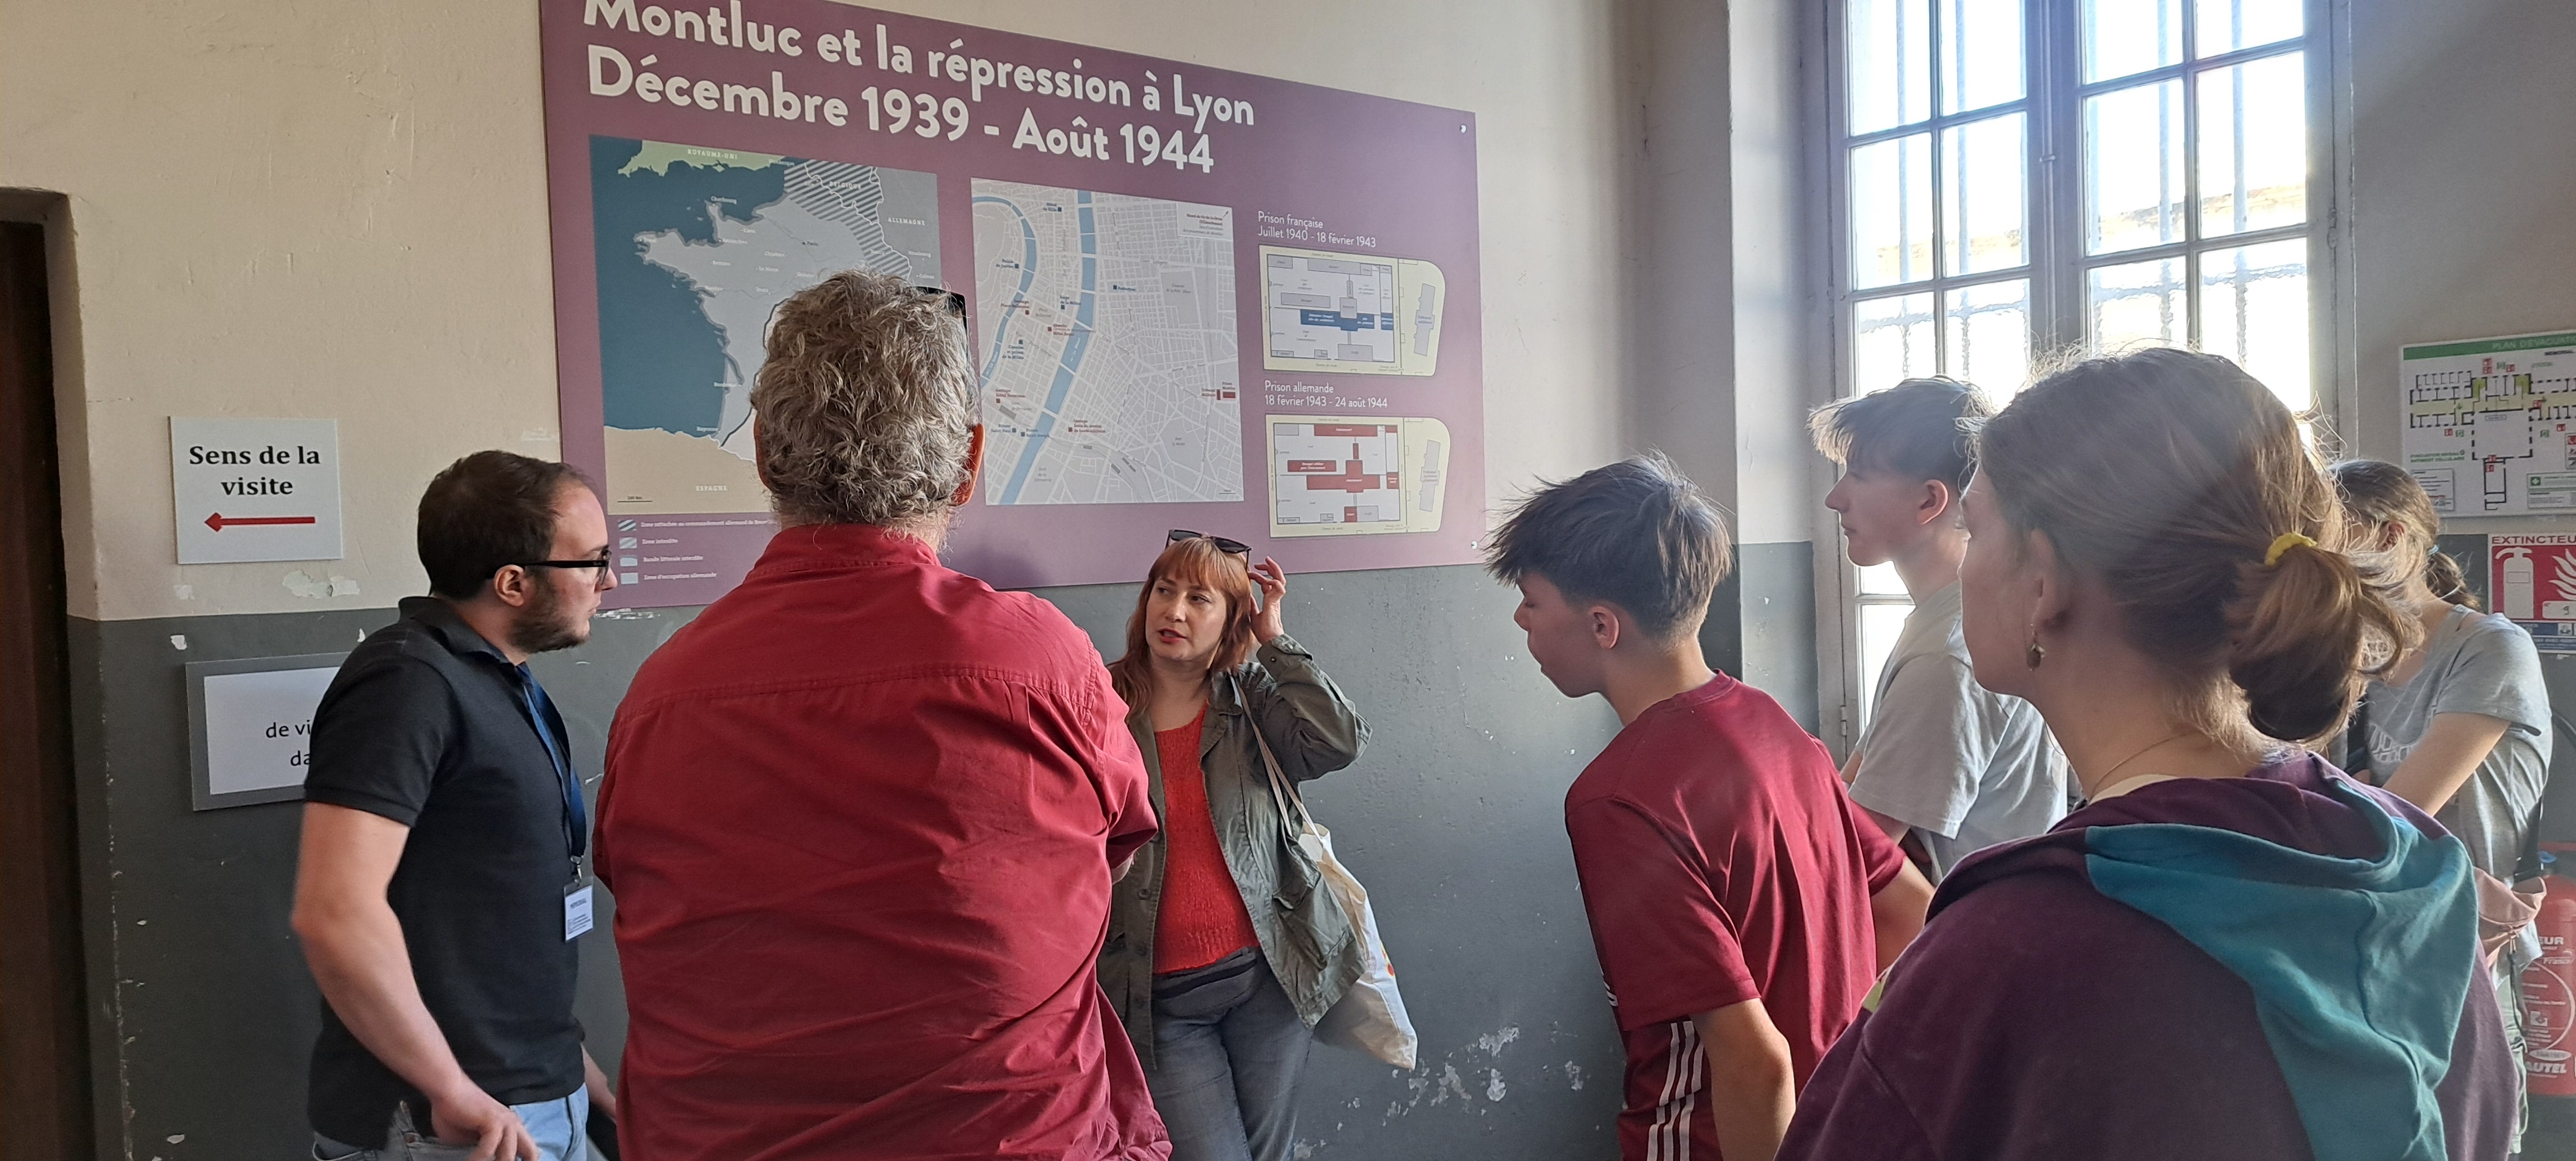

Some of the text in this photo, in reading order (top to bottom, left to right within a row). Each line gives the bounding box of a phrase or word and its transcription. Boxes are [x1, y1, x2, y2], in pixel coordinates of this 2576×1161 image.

[584, 0, 1254, 133] Montluc et la répression à Lyon
[588, 44, 1214, 173] Décembre 1939 - Août 1944
[887, 217, 925, 226] ALLEMAGNE
[1258, 211, 1323, 230] Prison française
[1258, 225, 1284, 238] Juillet
[1286, 228, 1308, 241] 1940
[1317, 232, 1326, 242] 18
[1329, 232, 1354, 246] février
[1356, 236, 1376, 247] 1943
[1265, 380, 1334, 393] Prison allemande
[1265, 394, 1275, 405] 18
[1277, 394, 1304, 406] février
[1306, 396, 1326, 406] 1943
[1335, 397, 1346, 407] 24
[1348, 397, 1366, 407] août
[1368, 397, 1388, 408] 1944
[189, 446, 320, 465] Sens de la
[221, 477, 293, 495] visite
[2491, 535, 2576, 545] EXTINCTEU
[266, 719, 311, 738] de vi
[290, 750, 311, 766] da
